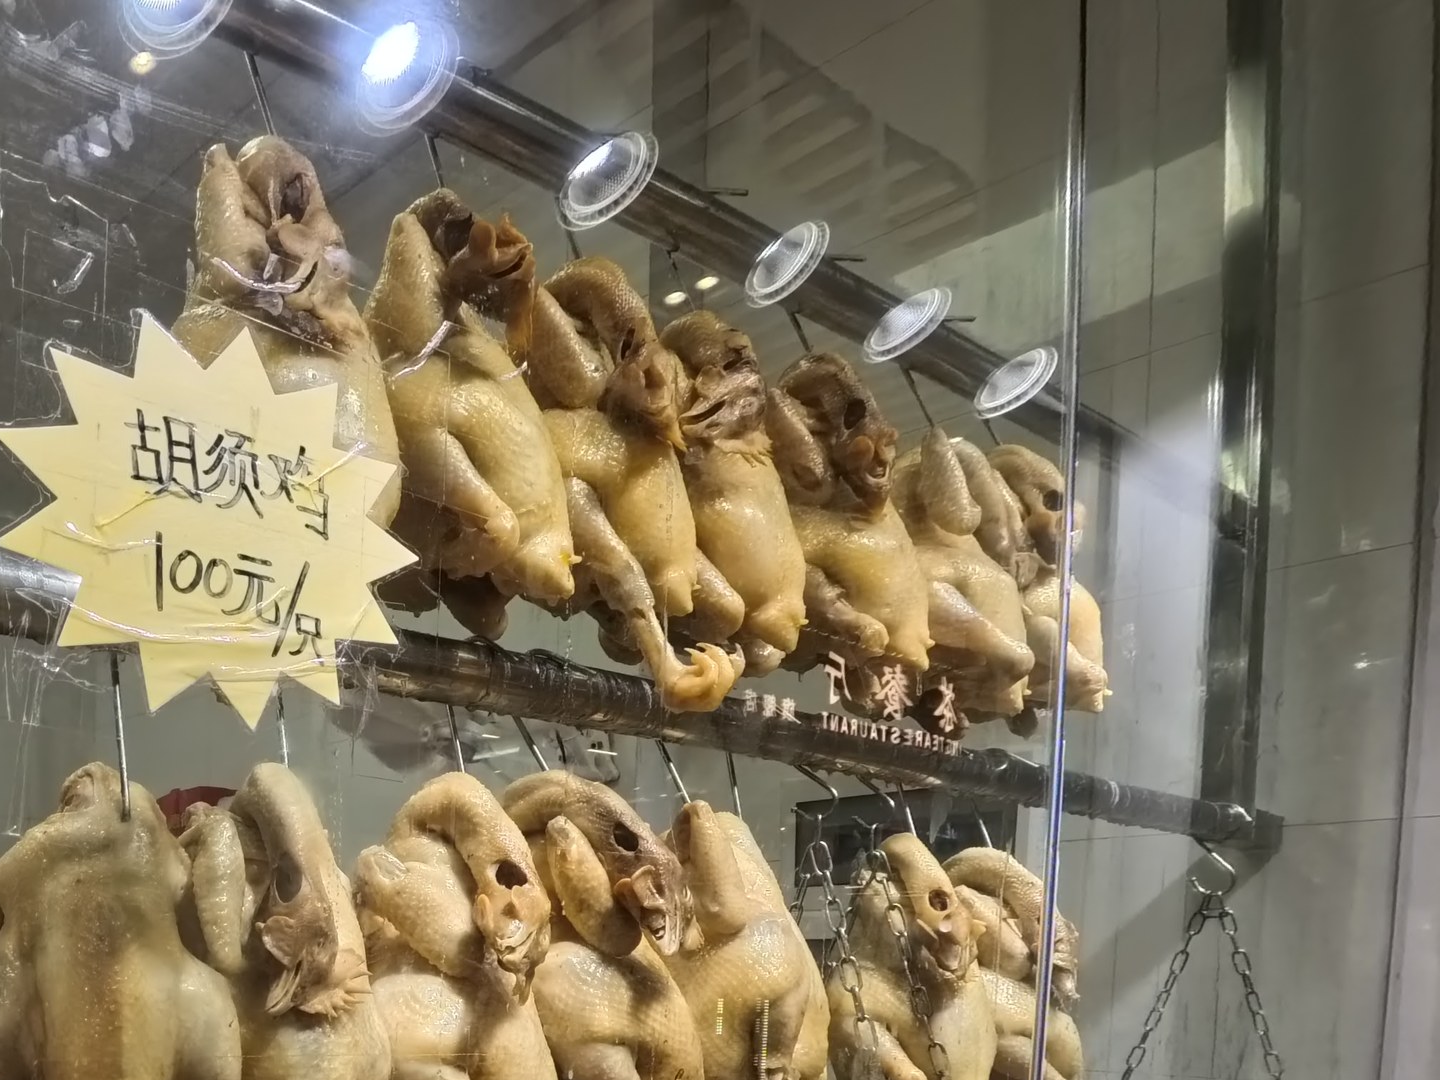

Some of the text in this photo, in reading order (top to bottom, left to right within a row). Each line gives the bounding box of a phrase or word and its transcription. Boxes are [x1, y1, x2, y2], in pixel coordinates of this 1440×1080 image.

[124, 408, 329, 540] 胡须鸡
[154, 531, 325, 666] 100元/只
